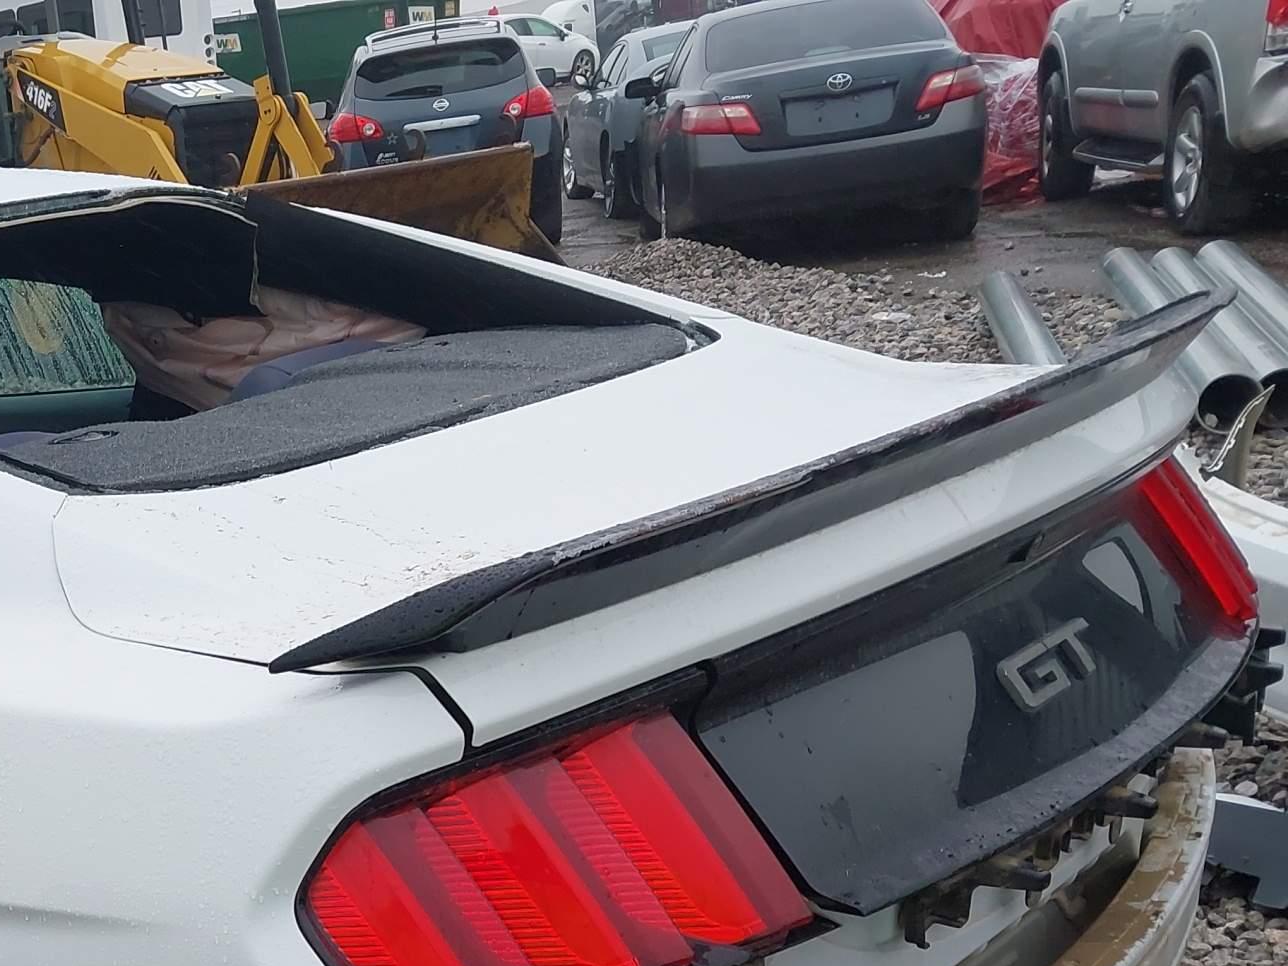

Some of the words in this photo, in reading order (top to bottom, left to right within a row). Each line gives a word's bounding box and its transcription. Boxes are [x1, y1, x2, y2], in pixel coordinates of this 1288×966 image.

[216, 38, 238, 49] WM
[160, 80, 234, 98] CAT
[996, 616, 1097, 711] GT
